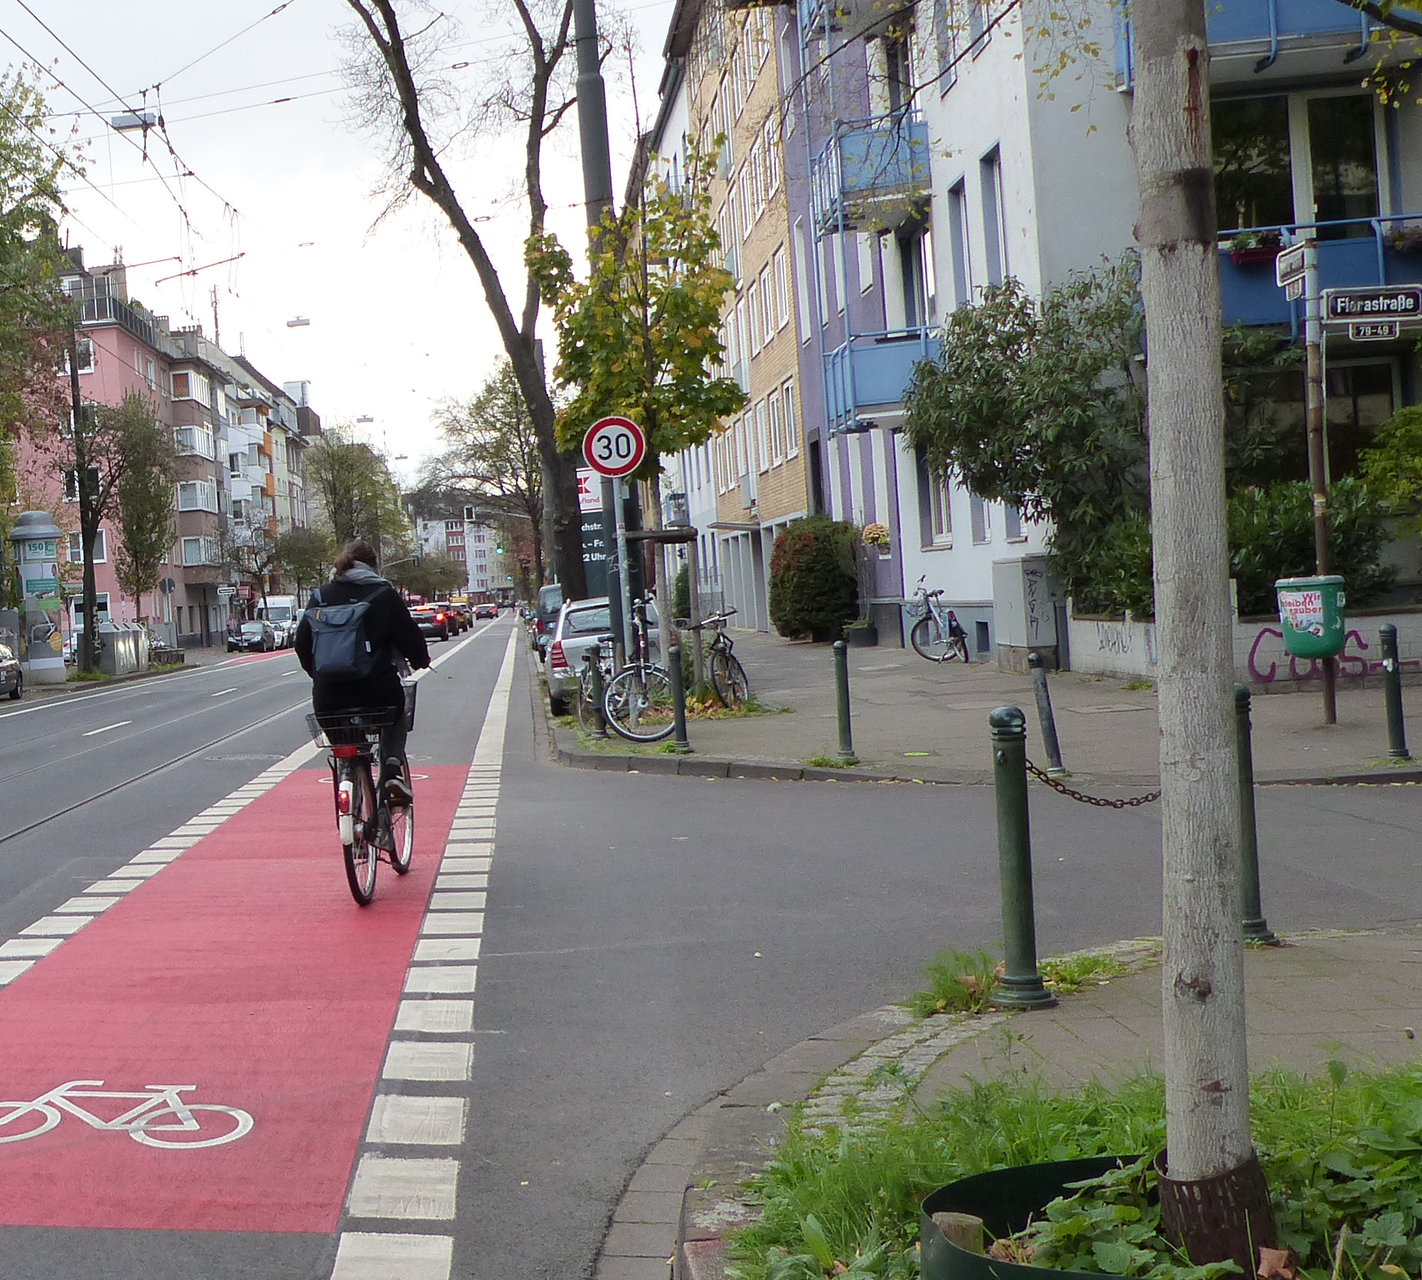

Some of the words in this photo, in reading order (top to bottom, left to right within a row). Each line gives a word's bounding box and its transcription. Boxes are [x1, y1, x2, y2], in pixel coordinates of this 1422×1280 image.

[1337, 294, 1414, 313] Florastraße
[1359, 325, 1389, 336] 79-49
[597, 433, 631, 460] 30
[581, 496, 600, 504] fland
[581, 523, 603, 532] chstr.
[28, 543, 43, 551] 150
[591, 552, 606, 561] Uhr
[1302, 592, 1322, 602] Wir
